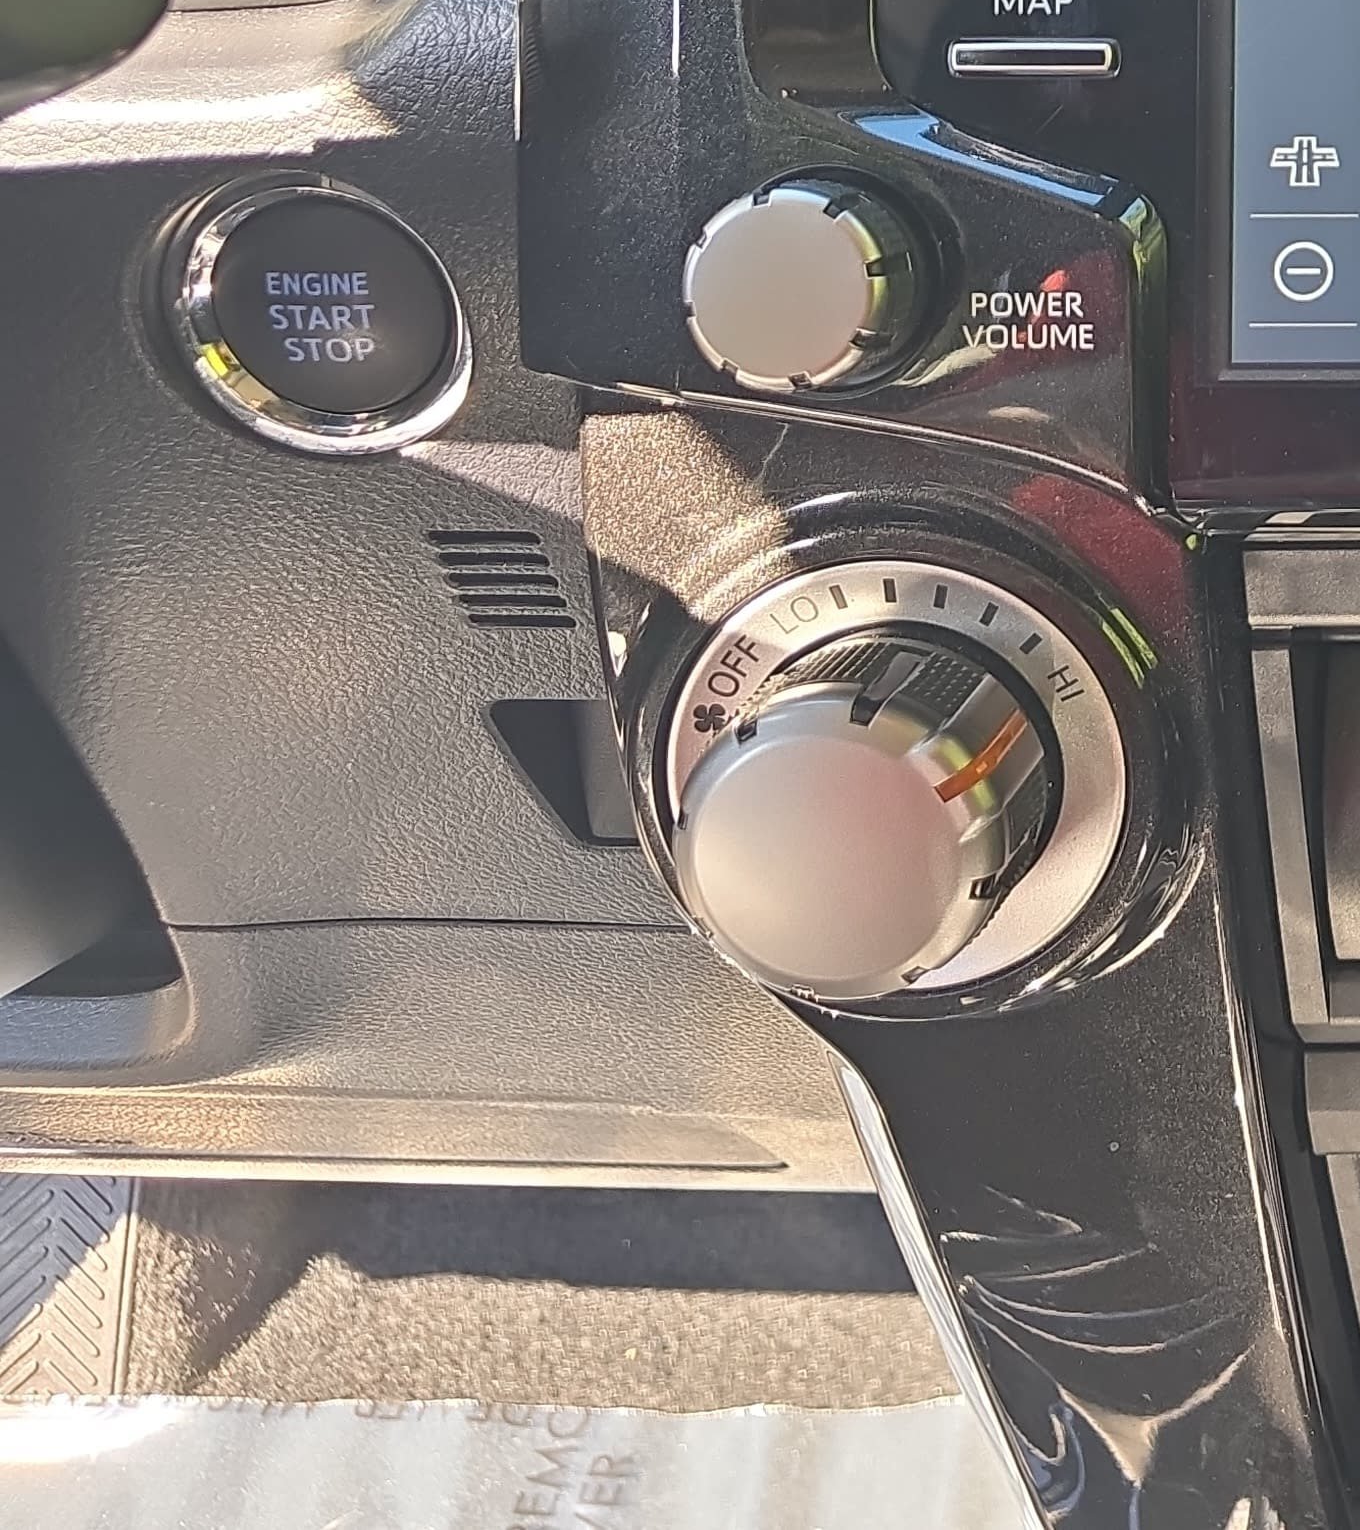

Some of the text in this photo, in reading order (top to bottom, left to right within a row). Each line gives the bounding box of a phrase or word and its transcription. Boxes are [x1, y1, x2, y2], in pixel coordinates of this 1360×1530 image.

[266, 271, 369, 297] ENGINE
[269, 304, 376, 331] START
[971, 292, 1085, 318] POWER
[284, 337, 376, 363] STOP
[962, 324, 1095, 350] VOLUME
[769, 595, 821, 635] LO
[707, 634, 762, 699] OFF
[1046, 664, 1085, 703] HI
